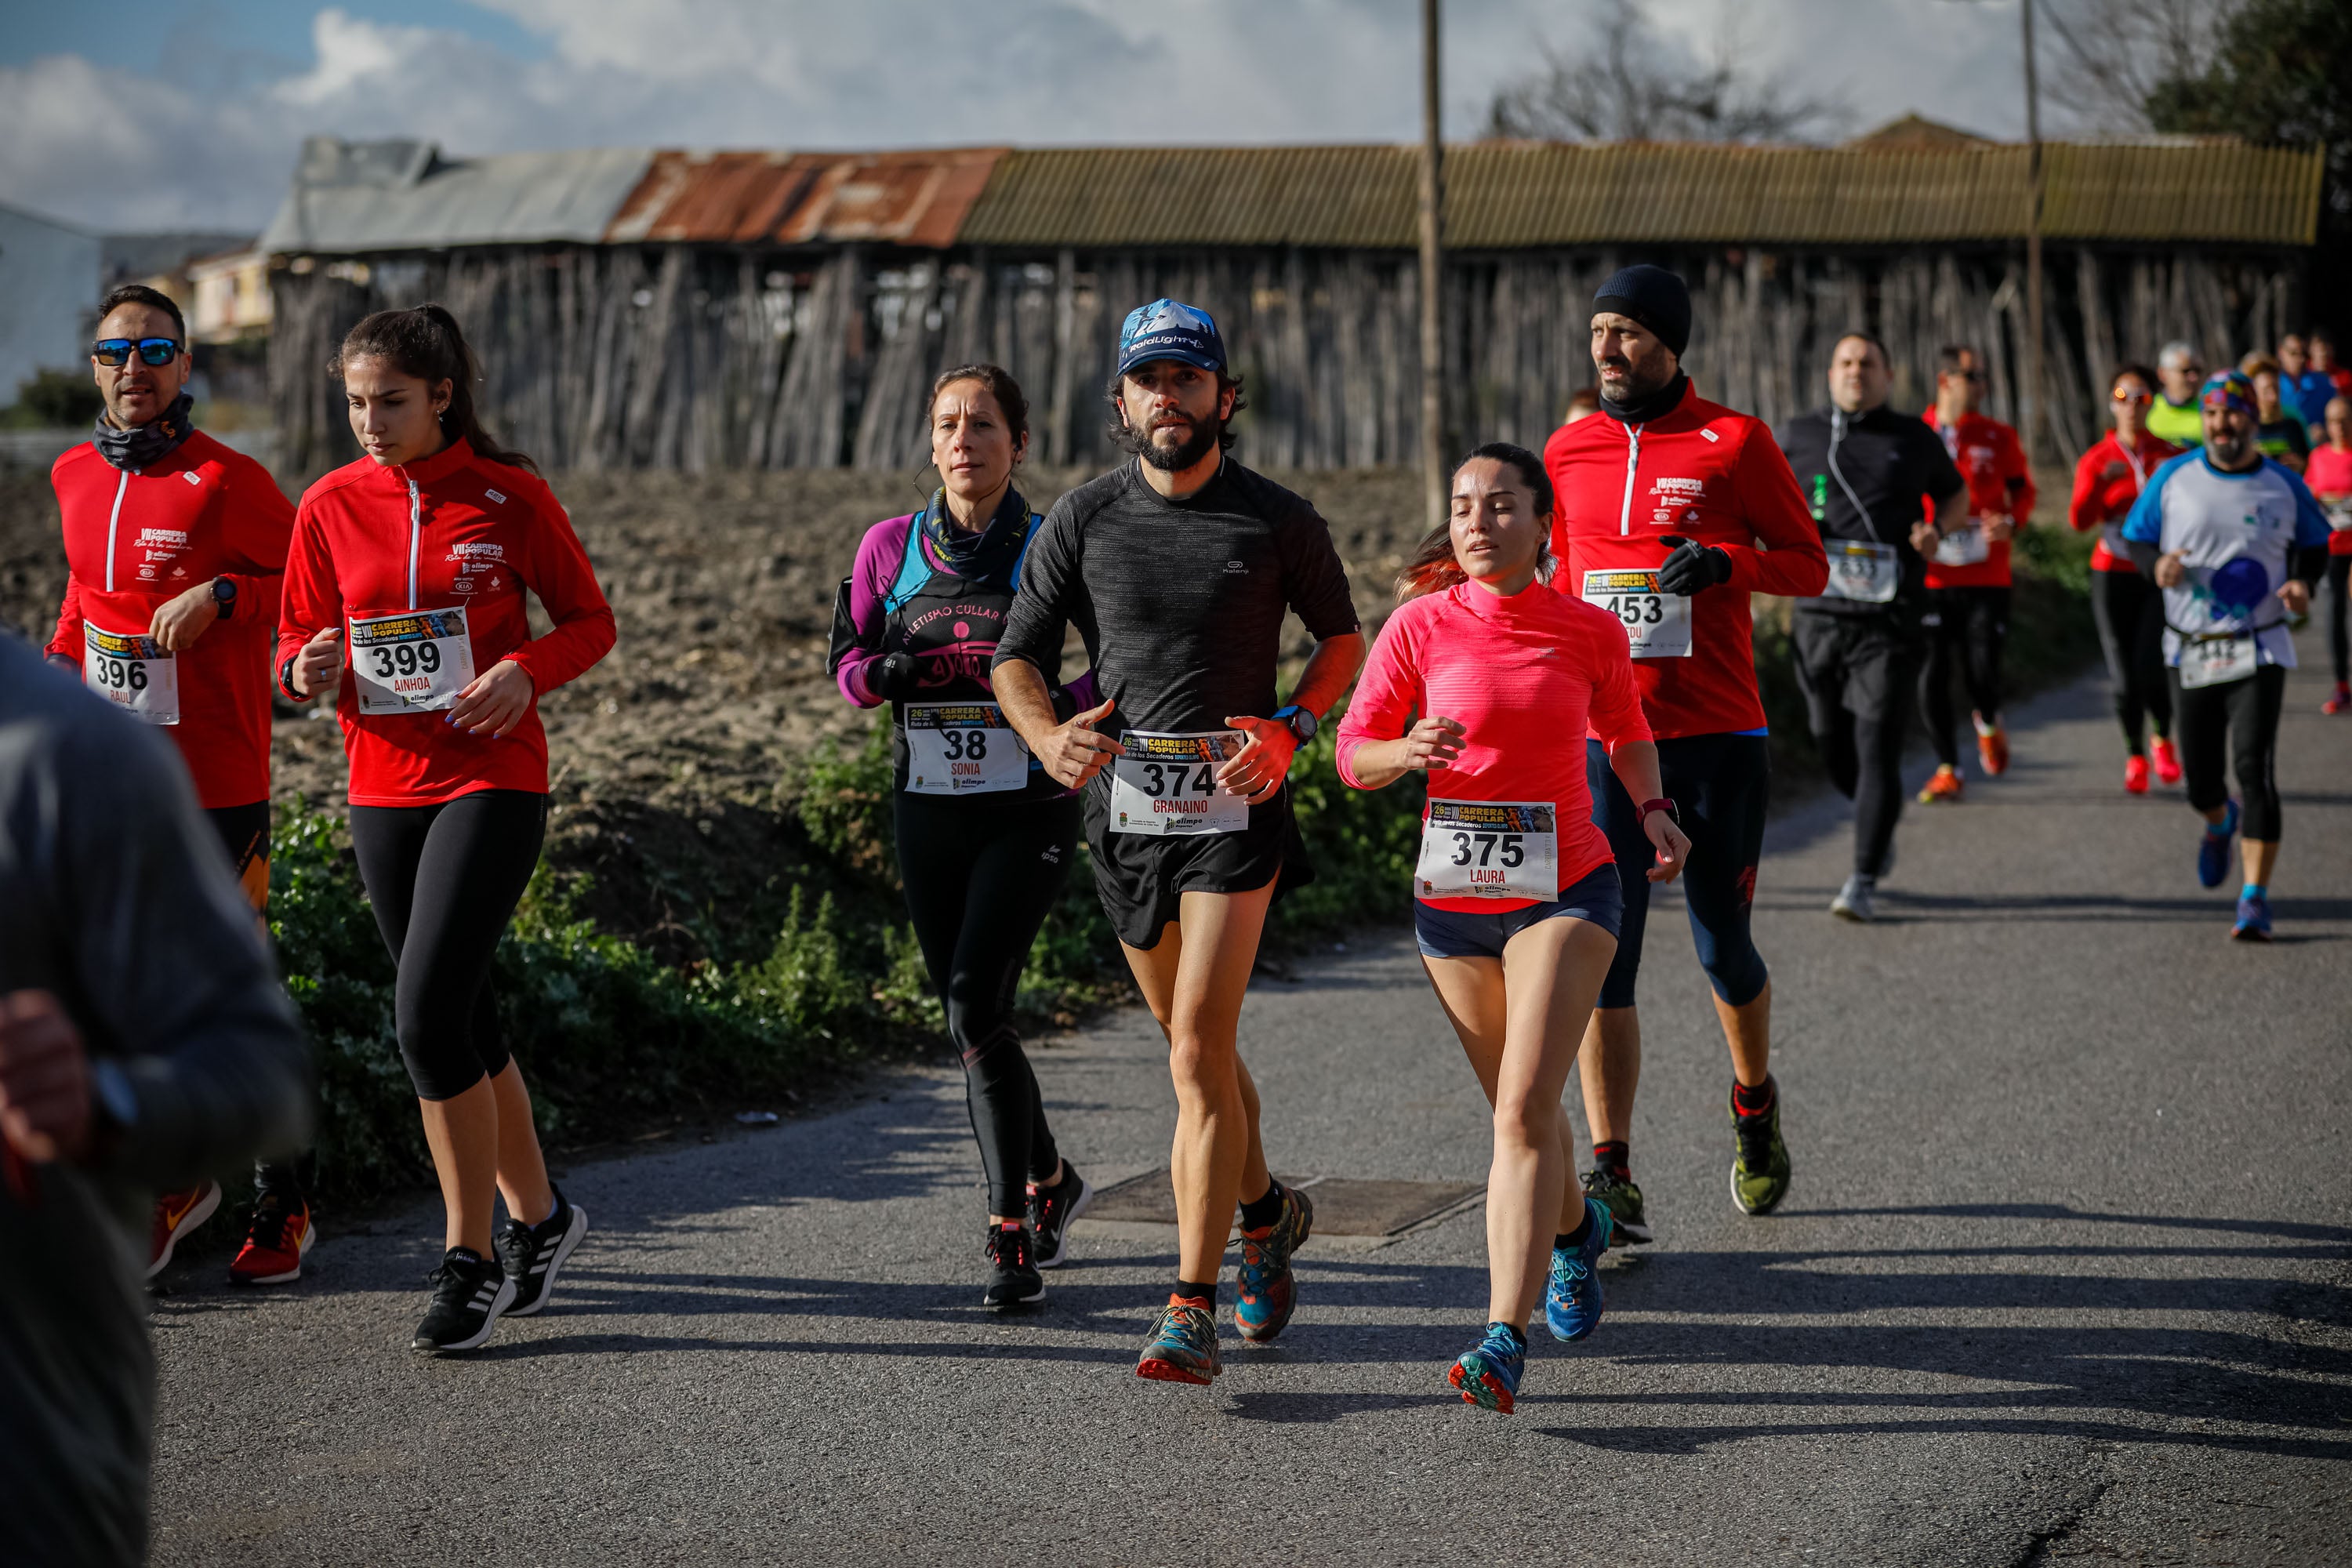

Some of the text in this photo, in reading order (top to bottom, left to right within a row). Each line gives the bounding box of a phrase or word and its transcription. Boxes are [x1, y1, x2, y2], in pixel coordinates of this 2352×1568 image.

[151, 535, 187, 543] POPULAR
[452, 544, 465, 554] VII
[465, 548, 503, 557] POPULAR
[1606, 596, 1662, 624] 453
[372, 619, 417, 631] CARRERA
[372, 626, 419, 637] POPULAR
[902, 604, 1000, 645] ATLETISMO CULLAR
[372, 641, 441, 678] 399
[96, 655, 147, 690] 396
[395, 677, 431, 692] AINHOA
[111, 690, 131, 704] RAUL
[911, 709, 923, 717] 26
[944, 730, 987, 760] 38
[1139, 738, 1148, 752] VII
[1148, 739, 1196, 747] CARRERA
[951, 763, 981, 775] SONIA
[1143, 764, 1217, 798] 374
[1153, 800, 1208, 813] GRANAINO
[1435, 805, 1444, 815] 26
[1459, 807, 1504, 816] CARRERA
[1451, 833, 1524, 868] 375
[1470, 869, 1506, 884] LAURA
